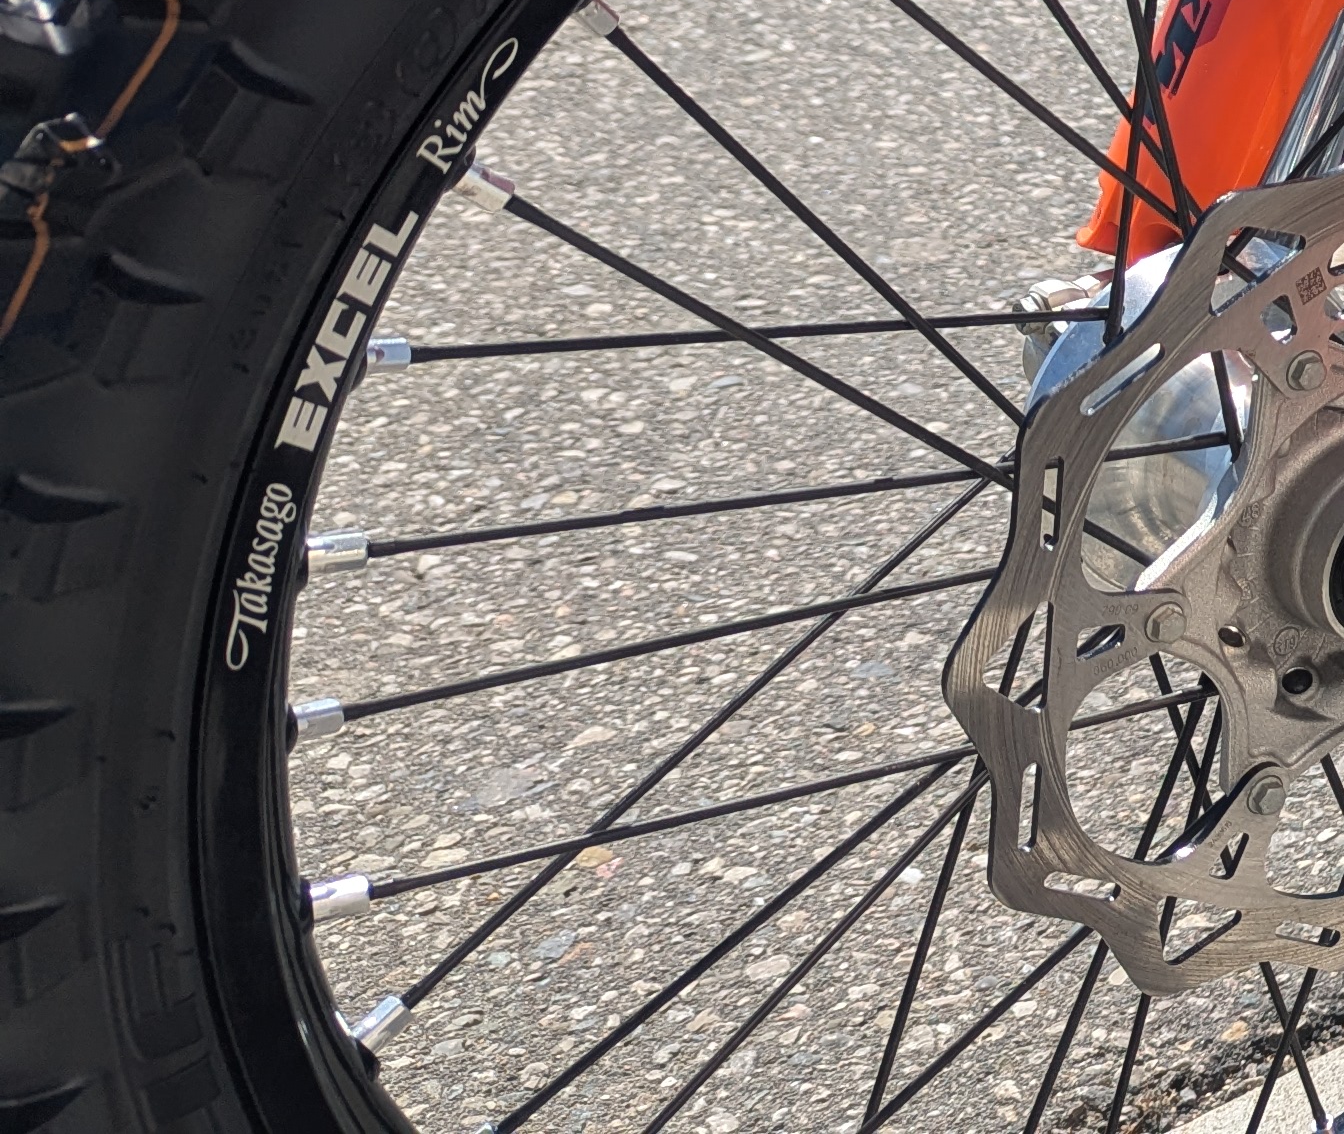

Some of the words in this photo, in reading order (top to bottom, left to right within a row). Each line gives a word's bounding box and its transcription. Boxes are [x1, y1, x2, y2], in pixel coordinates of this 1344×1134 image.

[226, 481, 297, 672] Takasago
[274, 210, 419, 452] EXCEL
[415, 37, 519, 175] Rim
